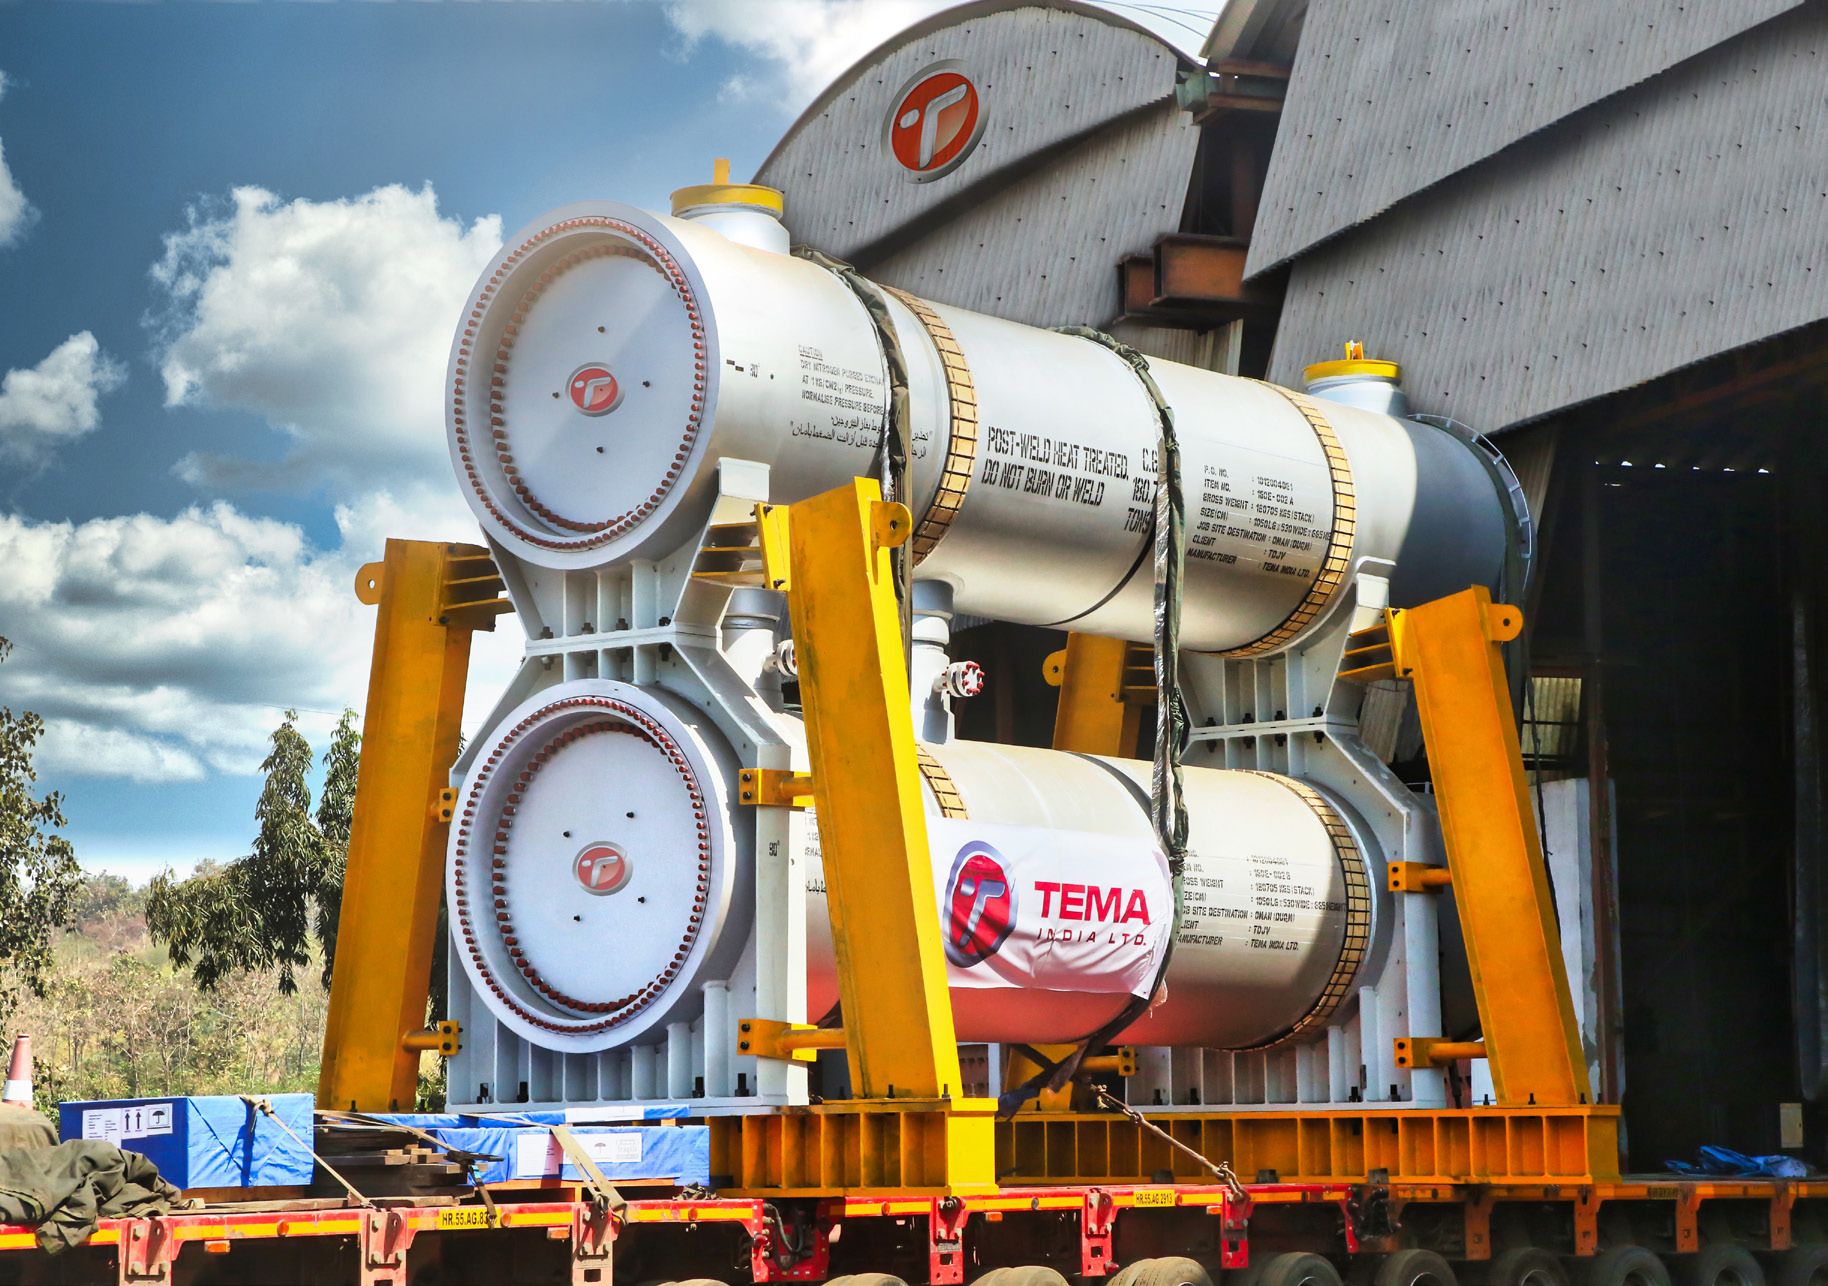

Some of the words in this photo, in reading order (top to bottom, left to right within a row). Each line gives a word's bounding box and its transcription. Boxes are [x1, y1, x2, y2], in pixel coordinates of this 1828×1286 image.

[834, 396, 862, 411] PRESSURE
[987, 425, 1050, 463] POST-WELD
[1052, 440, 1080, 470] HEAT
[1083, 446, 1129, 480] TREATED.
[981, 458, 999, 486] DO
[999, 463, 1024, 491] NOT
[1023, 467, 1055, 498] BURN
[1055, 473, 1073, 501] OR
[1073, 476, 1105, 506] WELD
[1204, 478, 1219, 490] ITEM
[1202, 492, 1223, 506] GROSS
[1225, 496, 1249, 511] WEIGHT
[1123, 507, 1151, 534] TONS
[1192, 534, 1217, 547] CLIENT
[1197, 521, 1211, 533] JOB
[1211, 524, 1226, 536] SITE
[1227, 527, 1267, 543] DESTINATION
[1272, 536, 1290, 548] OMAN
[1186, 547, 1238, 565] MANUFACTURER
[1200, 878, 1224, 889] WEIGHT
[1034, 880, 1151, 925] TEMA
[1192, 906, 1207, 917] SITE
[1208, 907, 1248, 919] DESTINATION
[1254, 911, 1272, 921] OMAN
[1036, 927, 1096, 943] INDIA
[1108, 932, 1147, 947] LTD.
[1177, 932, 1223, 946] ANUFACTURER
[1250, 938, 1267, 949] TEMA
[1268, 940, 1285, 951] INDIA
